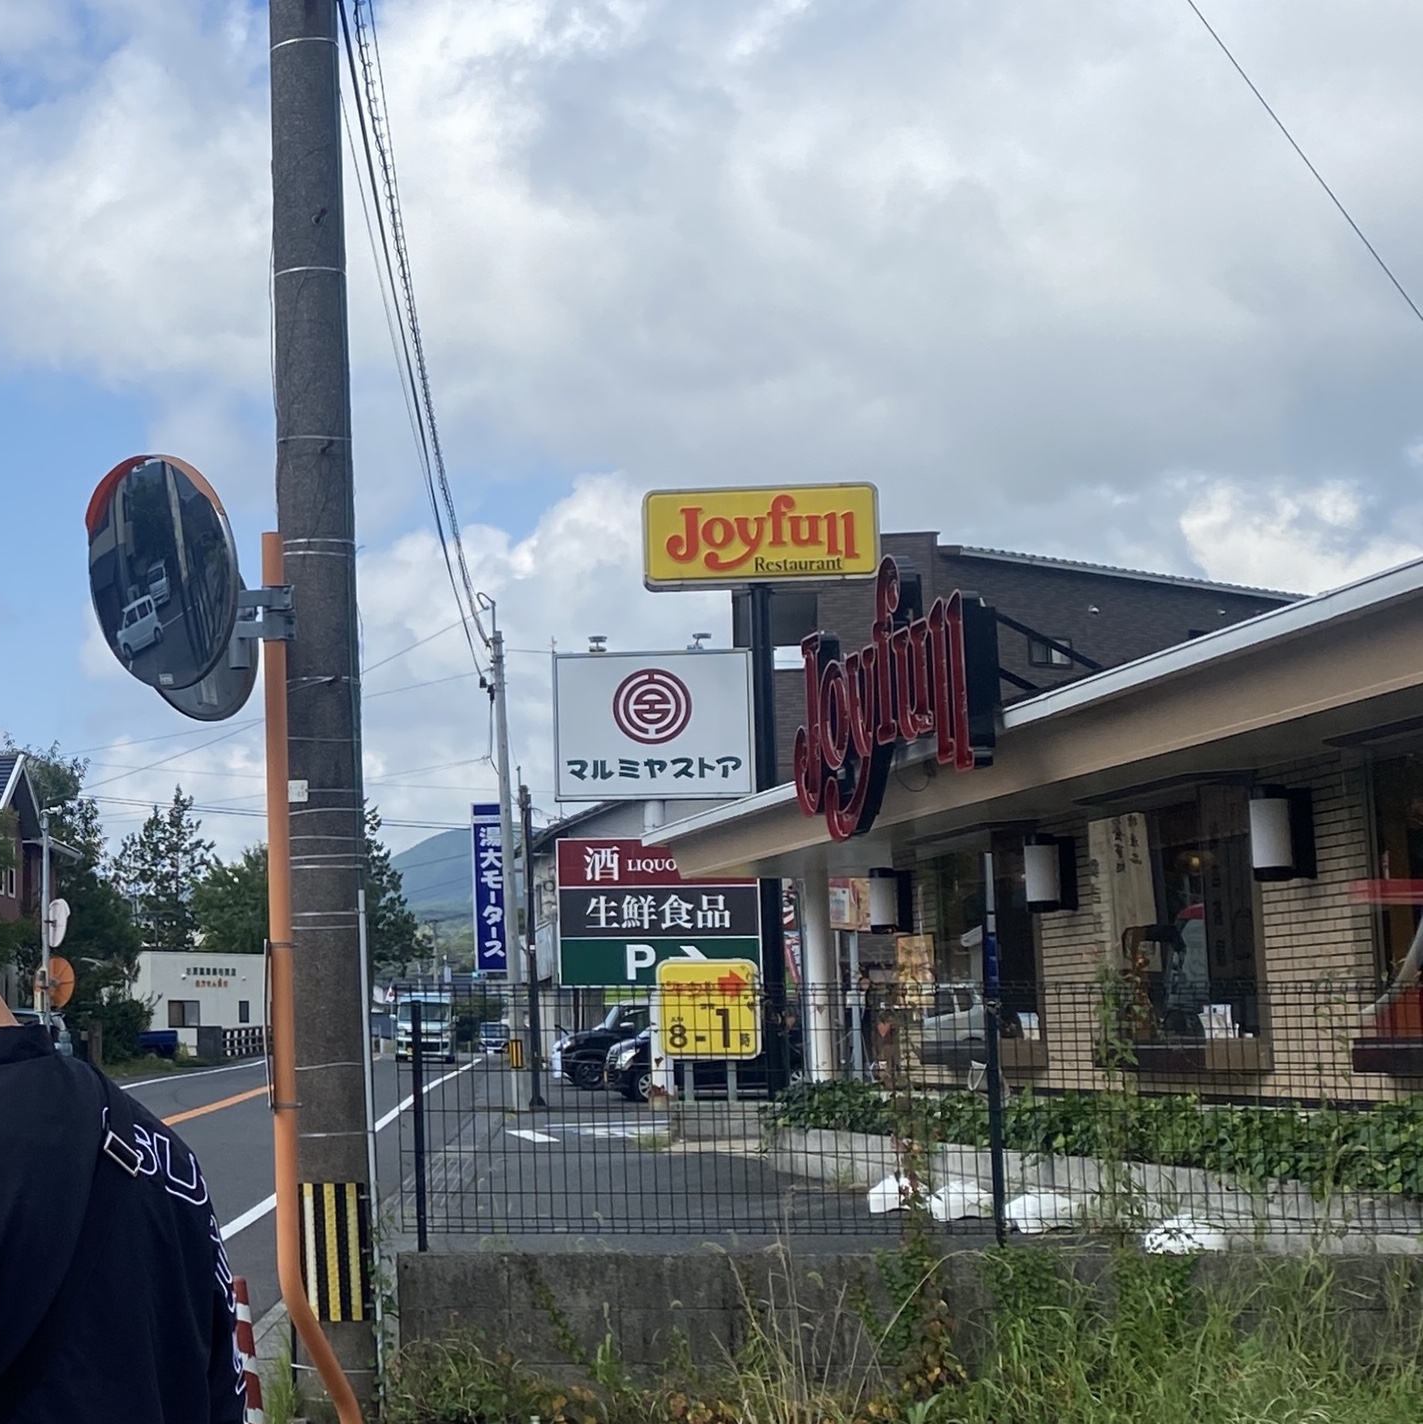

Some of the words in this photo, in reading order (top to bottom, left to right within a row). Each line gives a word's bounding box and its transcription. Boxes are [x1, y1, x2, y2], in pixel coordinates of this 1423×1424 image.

[666, 494, 860, 571] Joyfull
[754, 556, 842, 573] Restaurant
[794, 553, 975, 843] Joyfull
[566, 756, 742, 781] マルミヤストア
[584, 845, 620, 881] 酒
[627, 859, 677, 874] LIQUO
[585, 894, 731, 930] 生鮮食品
[626, 944, 656, 980] P
